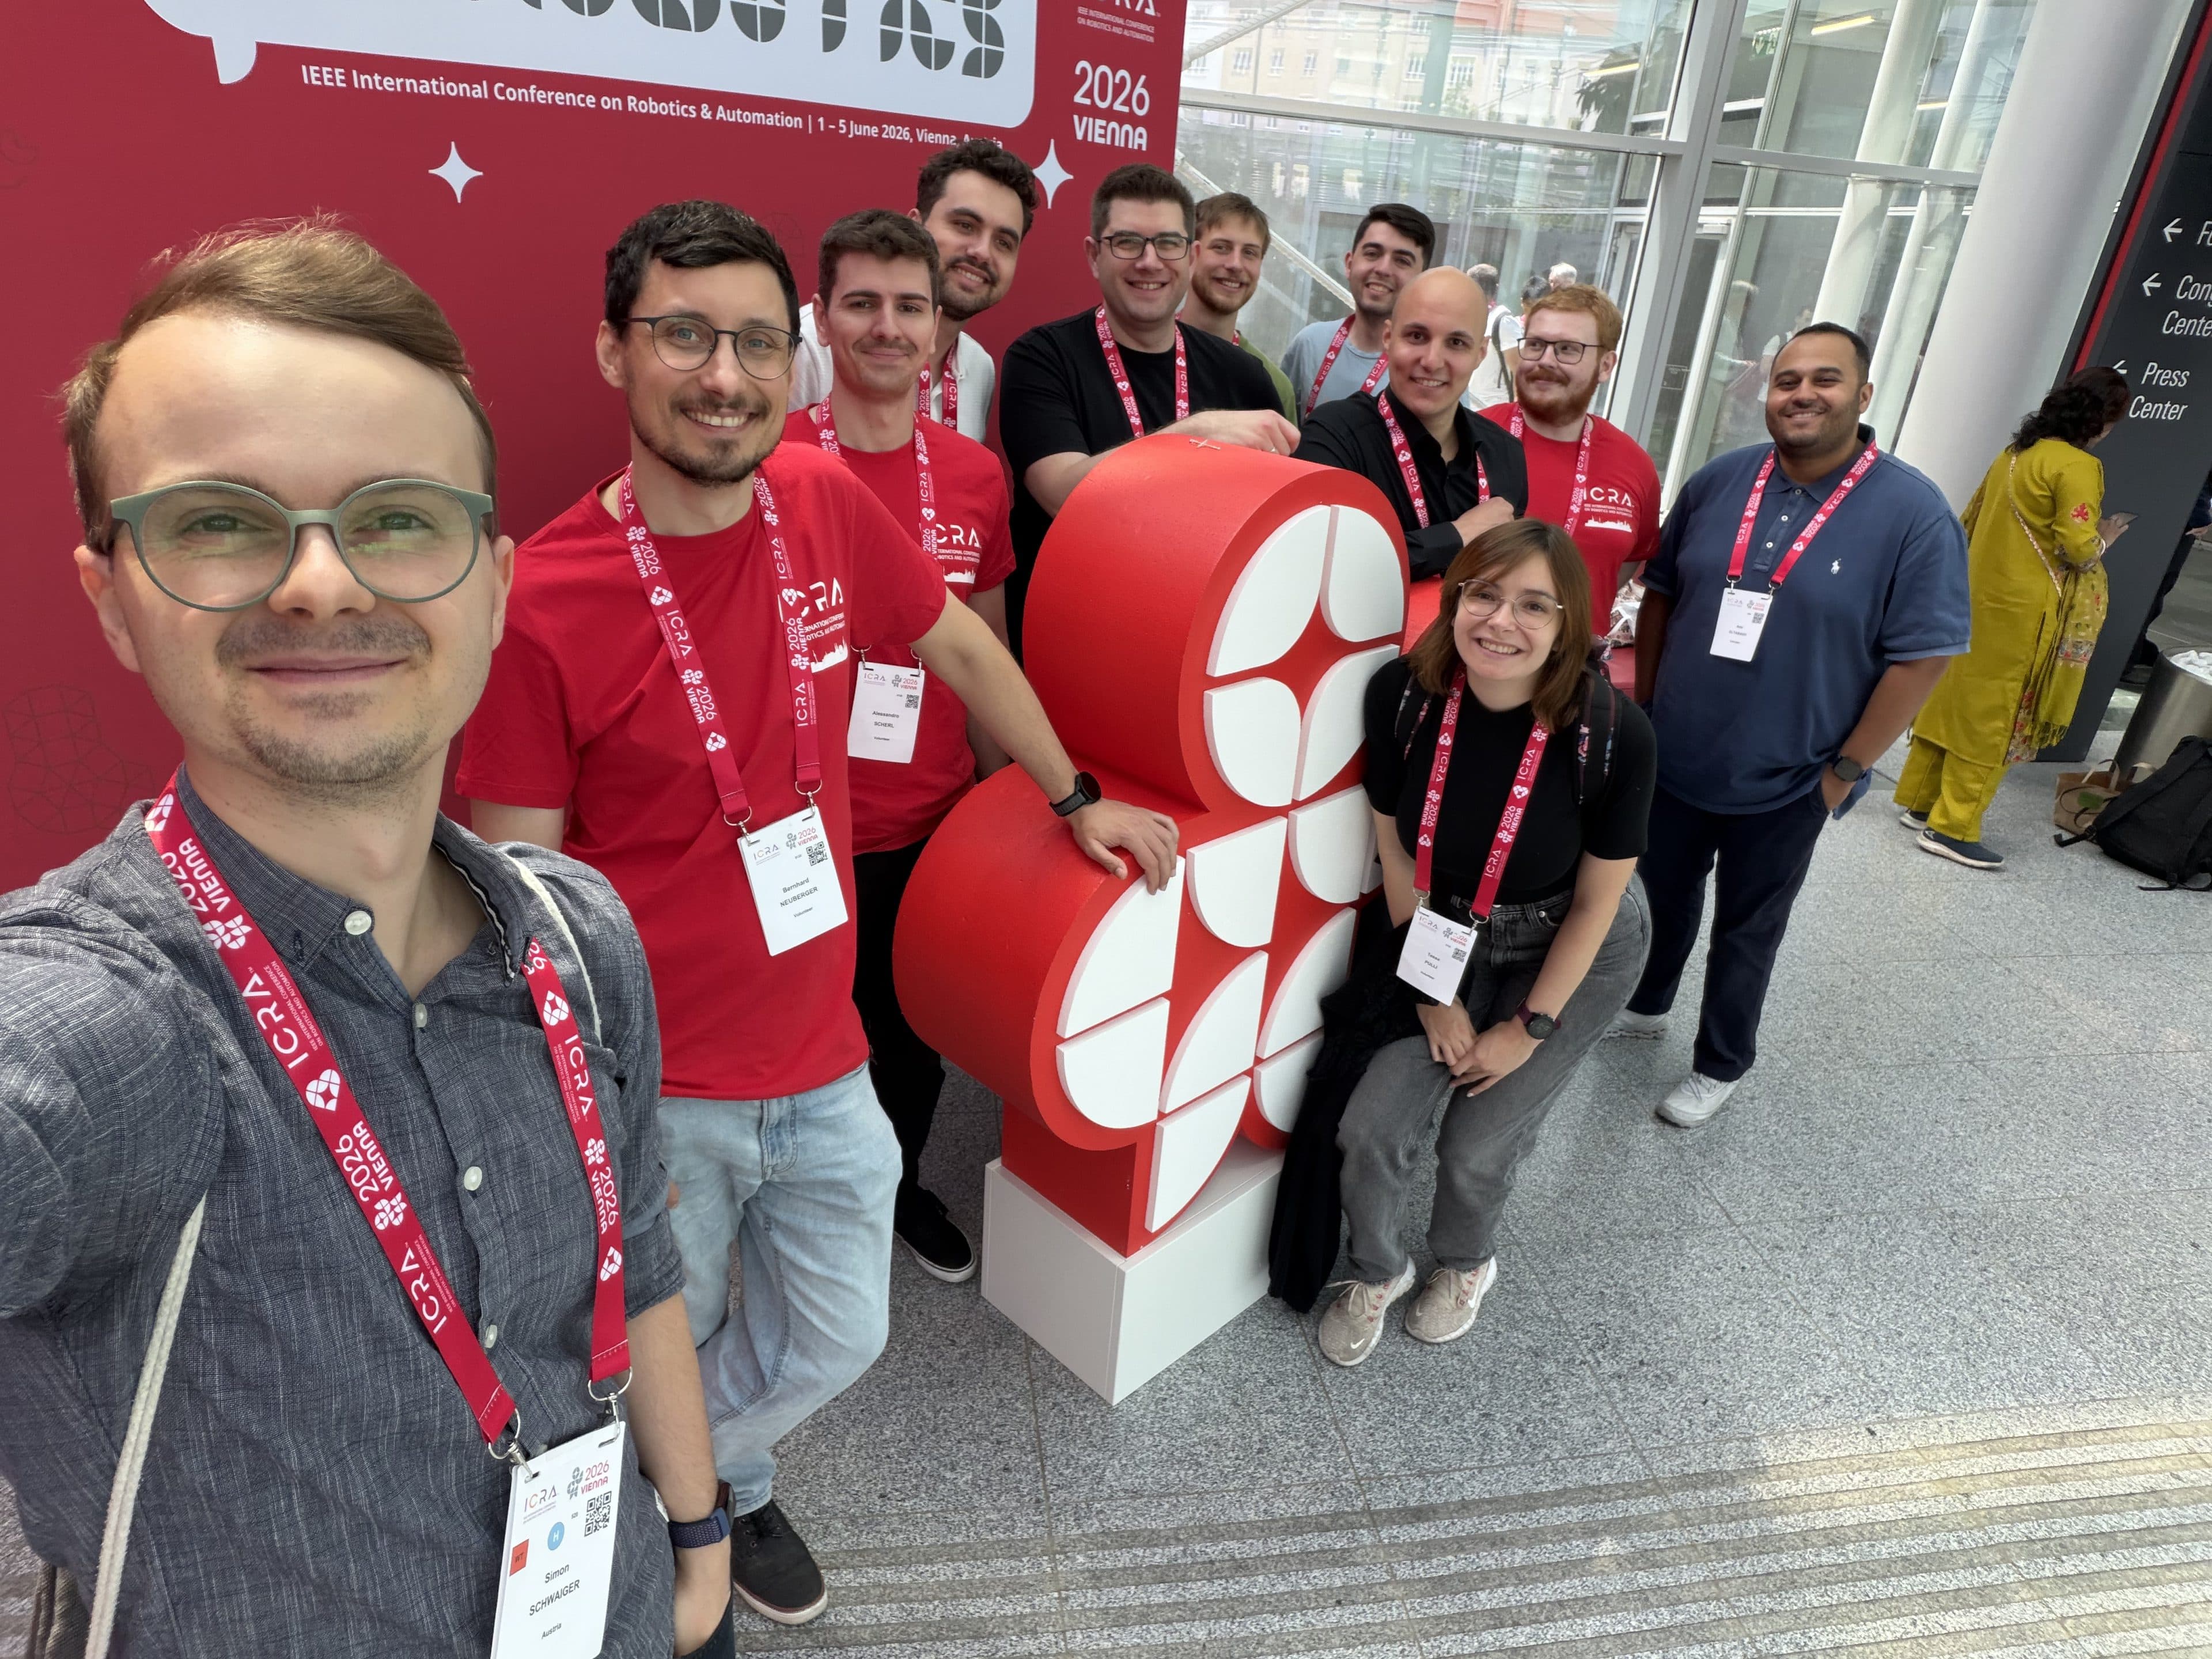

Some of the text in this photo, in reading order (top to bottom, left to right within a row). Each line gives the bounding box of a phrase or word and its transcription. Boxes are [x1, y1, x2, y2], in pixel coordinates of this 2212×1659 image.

[1073, 60, 1150, 116] 2026
[301, 65, 346, 87] IEEE
[352, 70, 488, 99] International
[494, 82, 596, 108] Conference
[601, 96, 622, 111] on
[627, 96, 696, 119] Robotics
[700, 104, 713, 119] &
[716, 105, 802, 129] Automation
[817, 117, 825, 131] 1
[839, 119, 847, 134] 5
[848, 120, 878, 138] June
[881, 125, 913, 143] 2026,
[1073, 114, 1147, 151] VIENNA
[2162, 310, 2212, 337] Cente
[1108, 354, 1121, 378] ICRA
[1319, 362, 1332, 380] ICRA
[1370, 359, 1385, 377] ICRA
[2141, 362, 2190, 387] Press
[949, 382, 957, 410] ICRA
[1123, 396, 1134, 415] 2026
[2128, 396, 2188, 421] Center
[1393, 425, 1406, 444] 2026
[1577, 450, 1585, 471] ICRA
[1759, 458, 1774, 478] ICRA
[1855, 460, 1870, 475] 2026
[919, 471, 929, 502] ICRA
[1407, 464, 1420, 491] ICRA
[623, 472, 635, 515] ICRA
[760, 478, 775, 509] VIENNA
[1571, 487, 1580, 504] 2026
[1583, 487, 1632, 507] ICRA
[1747, 492, 1757, 509] 2026
[1827, 490, 1847, 510] ICRA
[922, 528, 931, 552] 2026
[1736, 522, 1749, 544] ICRA
[1805, 522, 1821, 539] 2026
[630, 543, 649, 578] VIENNA
[640, 541, 662, 575] 2026
[771, 537, 788, 579] ICRA
[666, 609, 693, 657] ICRA
[786, 618, 800, 651] 2026
[796, 617, 808, 653] VIENNA
[864, 672, 885, 681] ICRA
[903, 677, 918, 685] 2026
[686, 687, 706, 724] VIENNA
[696, 686, 717, 720] 2026
[794, 682, 808, 727] ICRA
[872, 710, 899, 719] Alessandro
[1442, 699, 1452, 724] VIENNA
[1448, 702, 1458, 725] 2026
[1436, 751, 1449, 782] ICRA
[1517, 748, 1536, 780] ICRA
[1421, 801, 1431, 825] VIENNA
[1427, 804, 1438, 827] 2026
[1501, 805, 1516, 829] 2026
[1509, 808, 1523, 832] VIENNA
[797, 826, 816, 839] 2026
[797, 834, 819, 846] VIENNA
[753, 843, 779, 861] ICRA
[1484, 849, 1501, 877] ICRA
[179, 837, 230, 913] VIENNA
[783, 877, 809, 894] Bernhard
[780, 886, 819, 908] NEUBERGER
[263, 964, 289, 1000] CONFERENCE
[271, 960, 296, 996] AUTOMATION
[293, 997, 302, 1009] AND
[242, 972, 309, 1069] ICRA
[286, 999, 312, 1040] INTERNATIONAL
[300, 1010, 319, 1037] ROBOTICS
[565, 1033, 593, 1116] ICRA
[335, 1134, 380, 1202] 2026
[353, 1120, 393, 1192] VIENNA
[592, 1169, 608, 1234] VIENNA
[600, 1166, 619, 1225] 2026
[400, 1247, 447, 1335] ICRA
[585, 1460, 609, 1481] 2026
[524, 1484, 557, 1512] ICRA
[581, 1476, 608, 1495] VIENNA
[544, 1564, 569, 1584] Simon
[529, 1579, 580, 1616] SCHWAIGER
[541, 1622, 562, 1639] Austria
